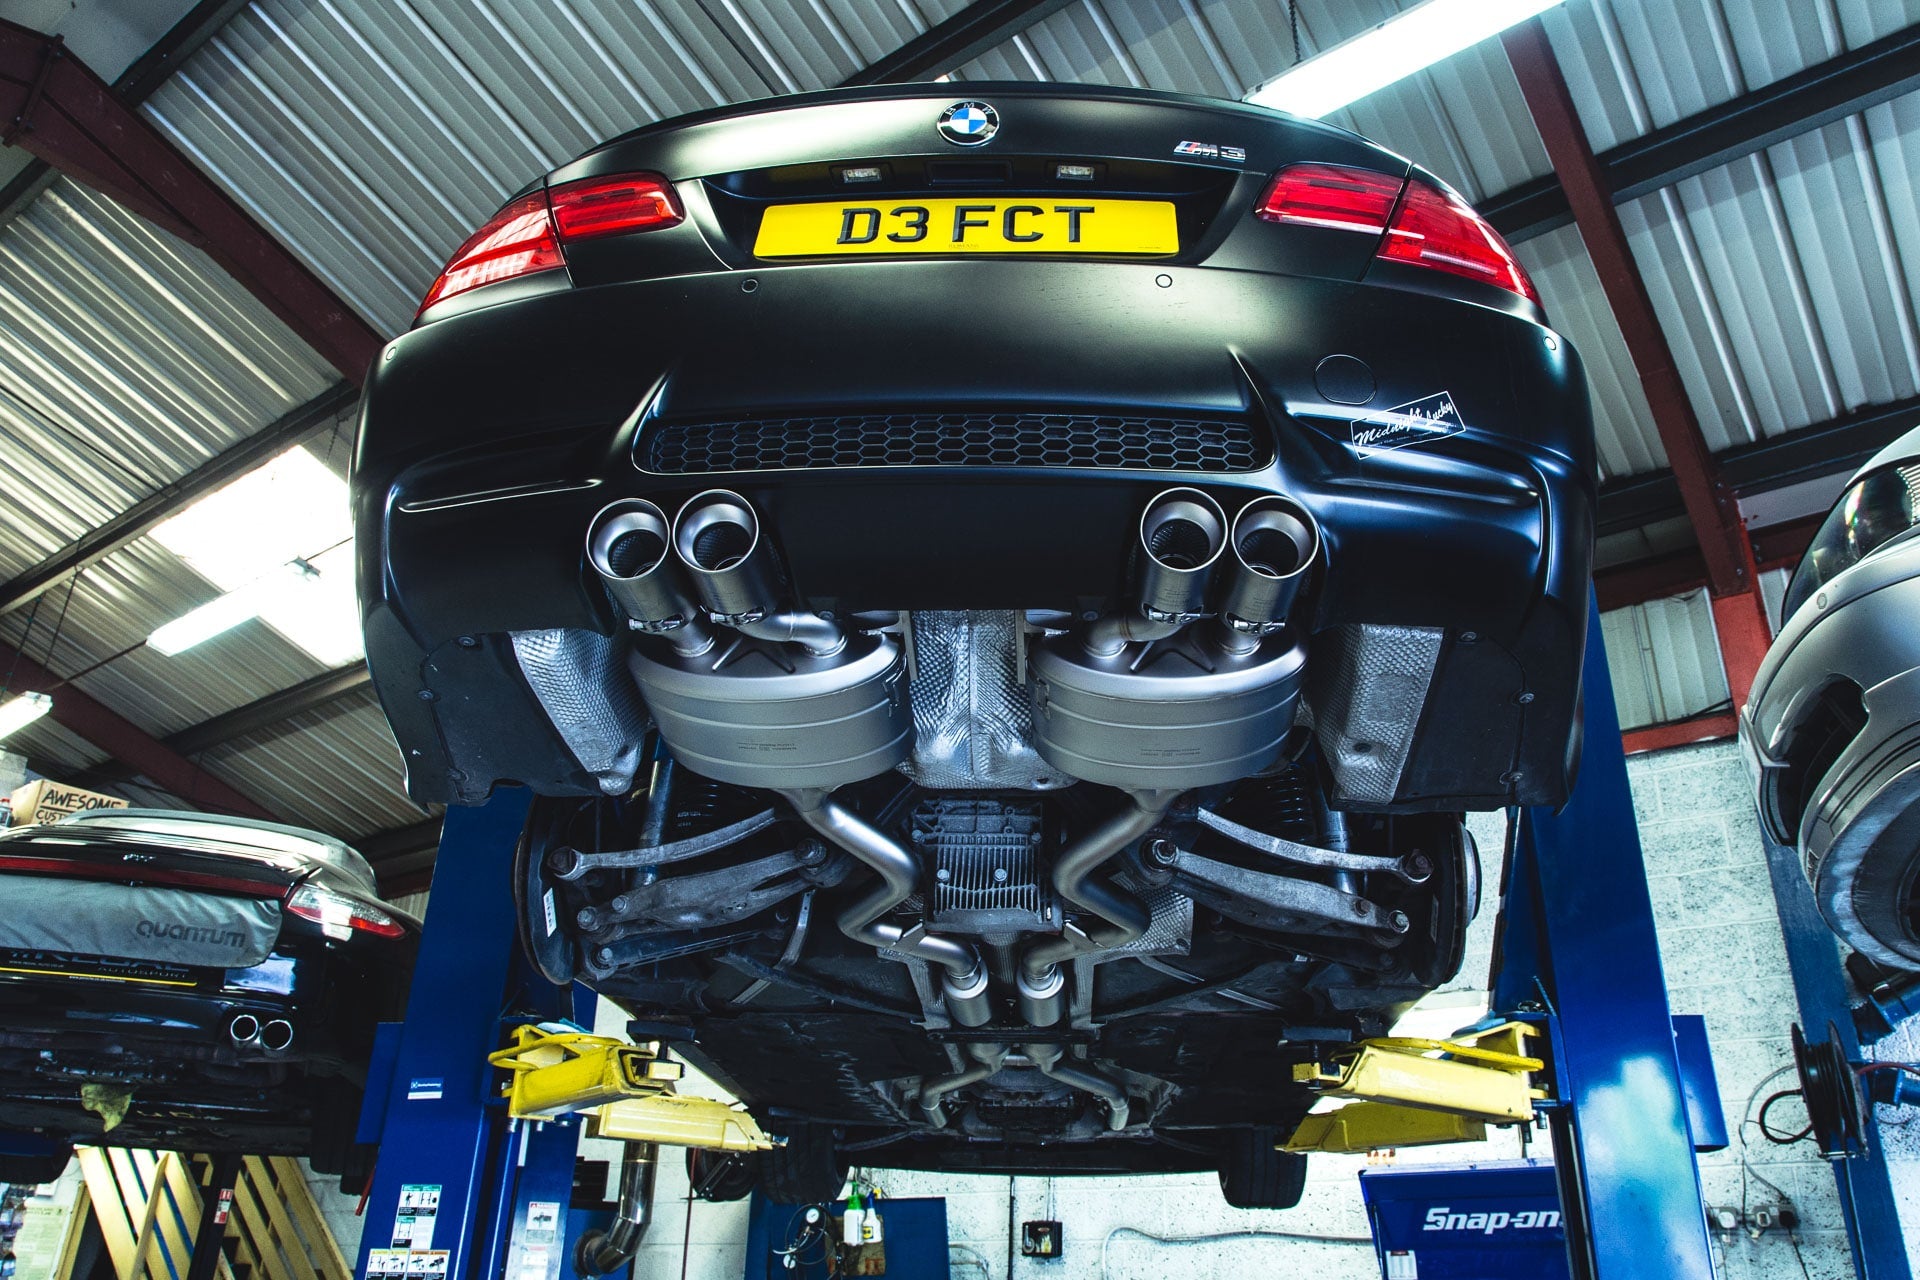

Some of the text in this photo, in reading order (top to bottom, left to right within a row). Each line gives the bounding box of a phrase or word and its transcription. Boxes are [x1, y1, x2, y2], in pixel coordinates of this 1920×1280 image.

[1174, 140, 1246, 163] M3
[837, 205, 1095, 245] D3 FCT
